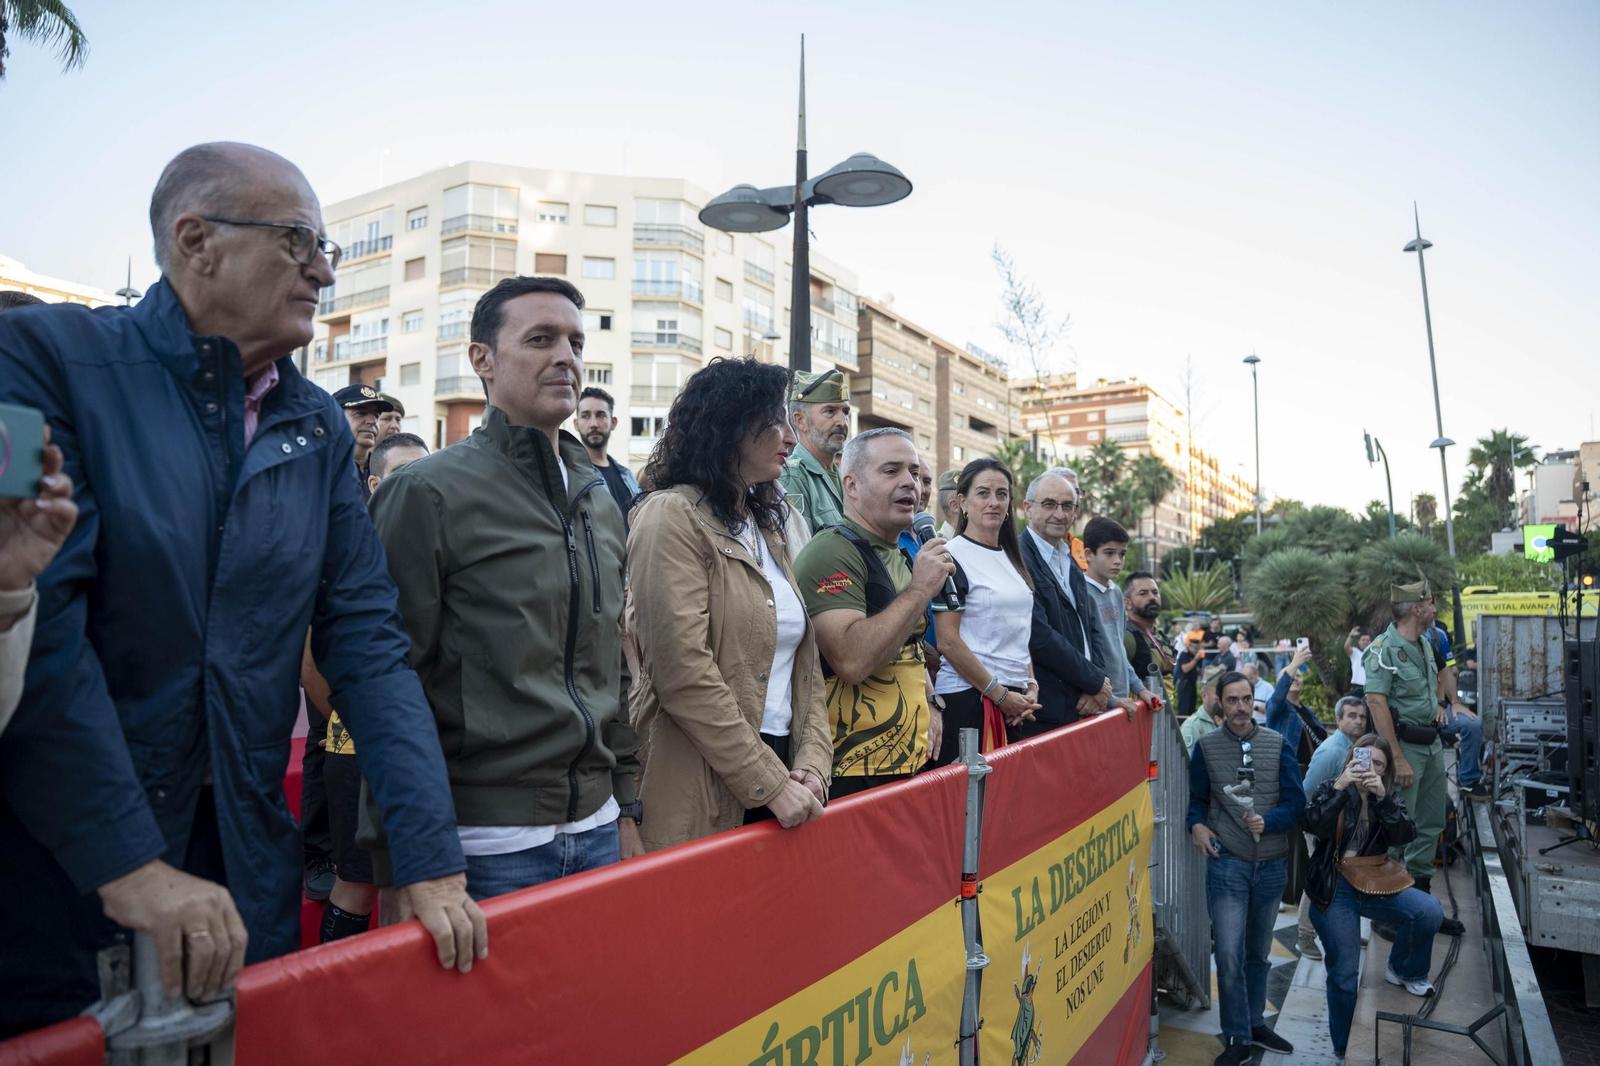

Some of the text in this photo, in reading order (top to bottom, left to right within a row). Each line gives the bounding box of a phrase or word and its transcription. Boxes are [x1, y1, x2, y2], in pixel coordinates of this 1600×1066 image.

[1492, 603, 1517, 611] VITAL
[1519, 603, 1570, 611] AVANZA
[1011, 809, 1140, 943] LA DESÉRTICA
[1054, 890, 1112, 960] LA LEGIÓN Y
[1055, 922, 1112, 994] EL DESIERTO
[1065, 961, 1105, 1020] NOS UNE
